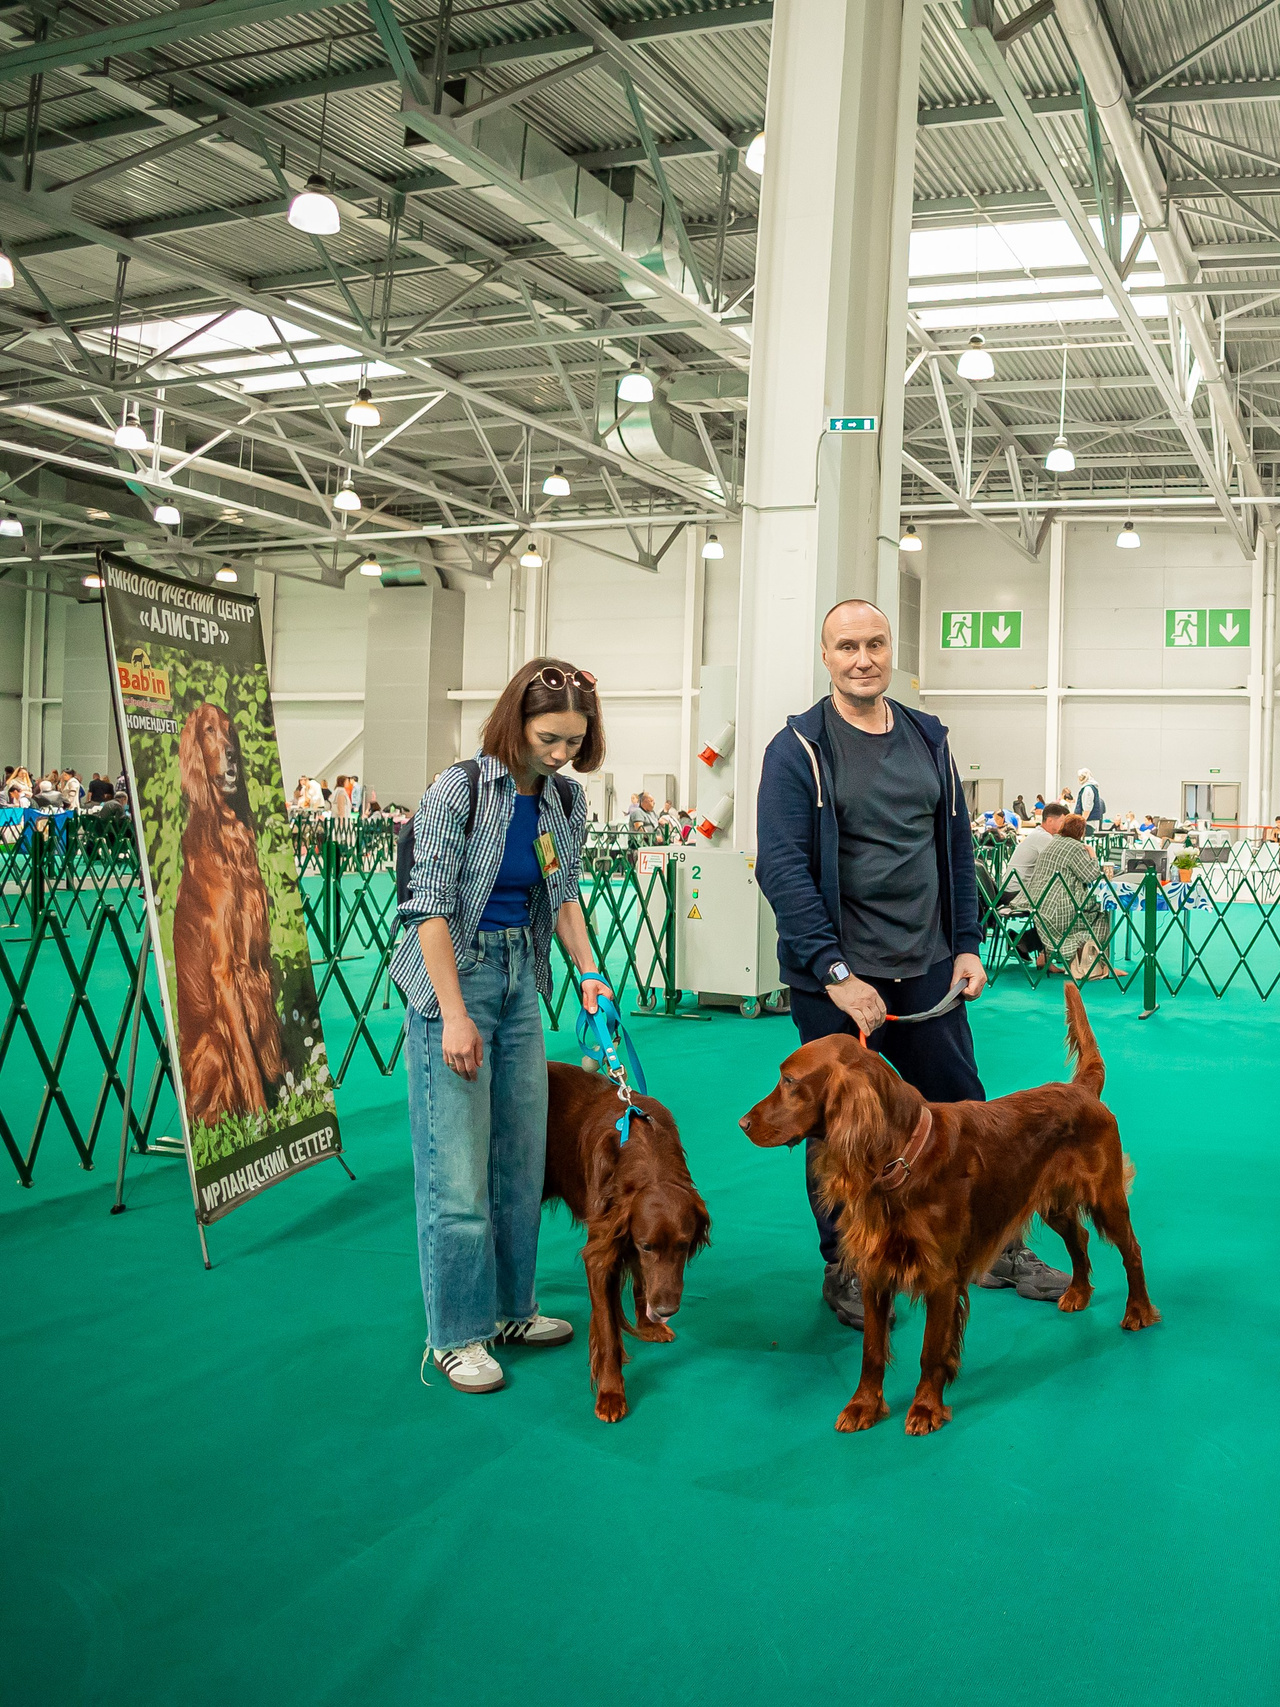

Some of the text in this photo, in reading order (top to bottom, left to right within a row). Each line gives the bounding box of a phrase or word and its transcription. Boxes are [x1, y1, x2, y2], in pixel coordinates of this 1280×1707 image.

[107, 565, 255, 624] КИНОЛОГИЧЕСКИЙ ЦЕНТР
[139, 606, 230, 645] «АЛИСТЭР»
[692, 865, 701, 879] 2
[201, 1126, 334, 1211] ИРЛАНДСКИЙ СЕТТЕР
